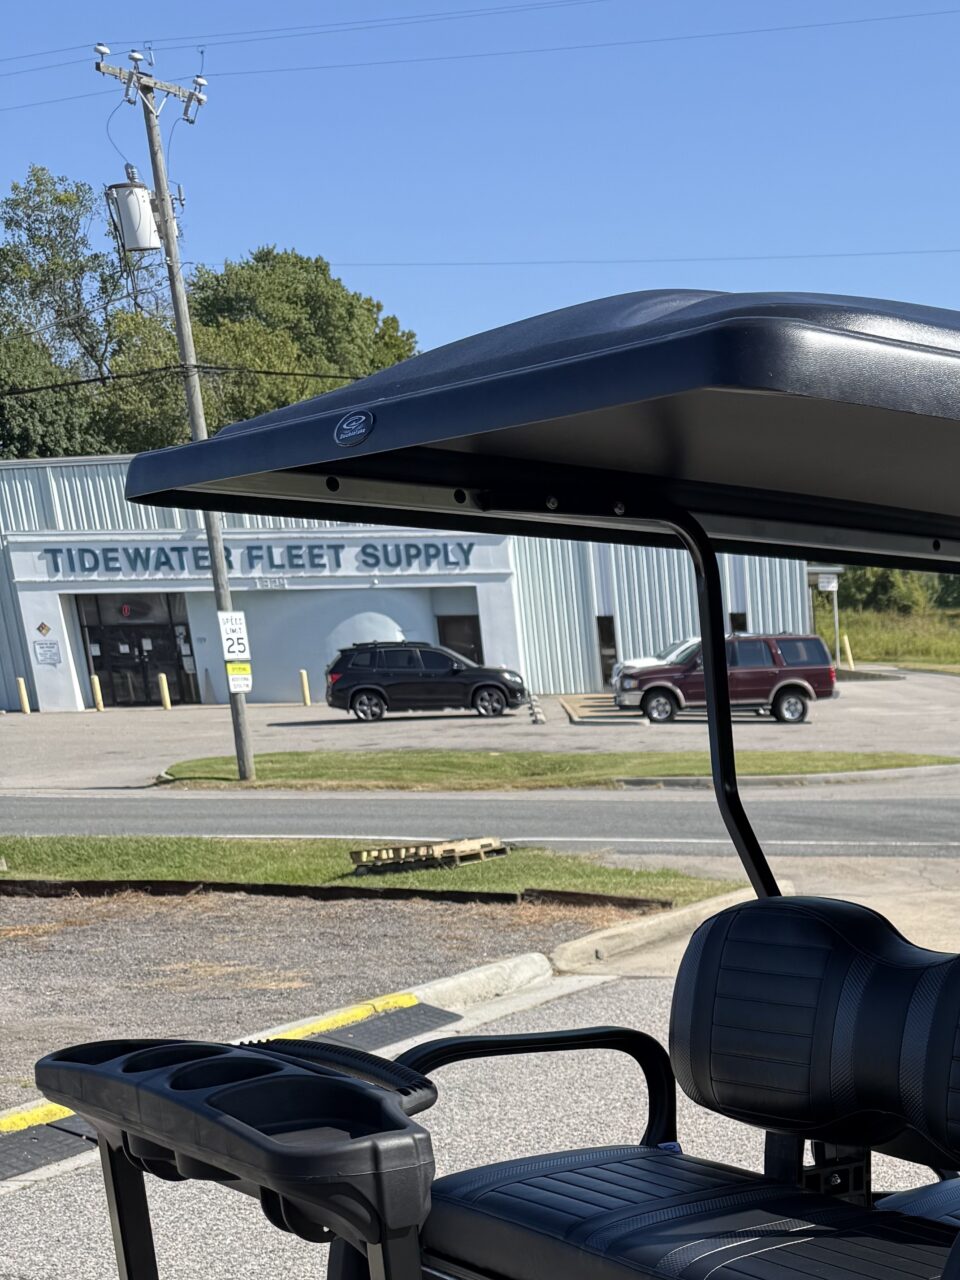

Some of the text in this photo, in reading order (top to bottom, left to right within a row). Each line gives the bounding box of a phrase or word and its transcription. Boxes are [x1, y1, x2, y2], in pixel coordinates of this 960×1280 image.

[246, 543, 345, 570] FLEET
[361, 542, 475, 568] SUPPLY
[226, 637, 247, 654] 25
